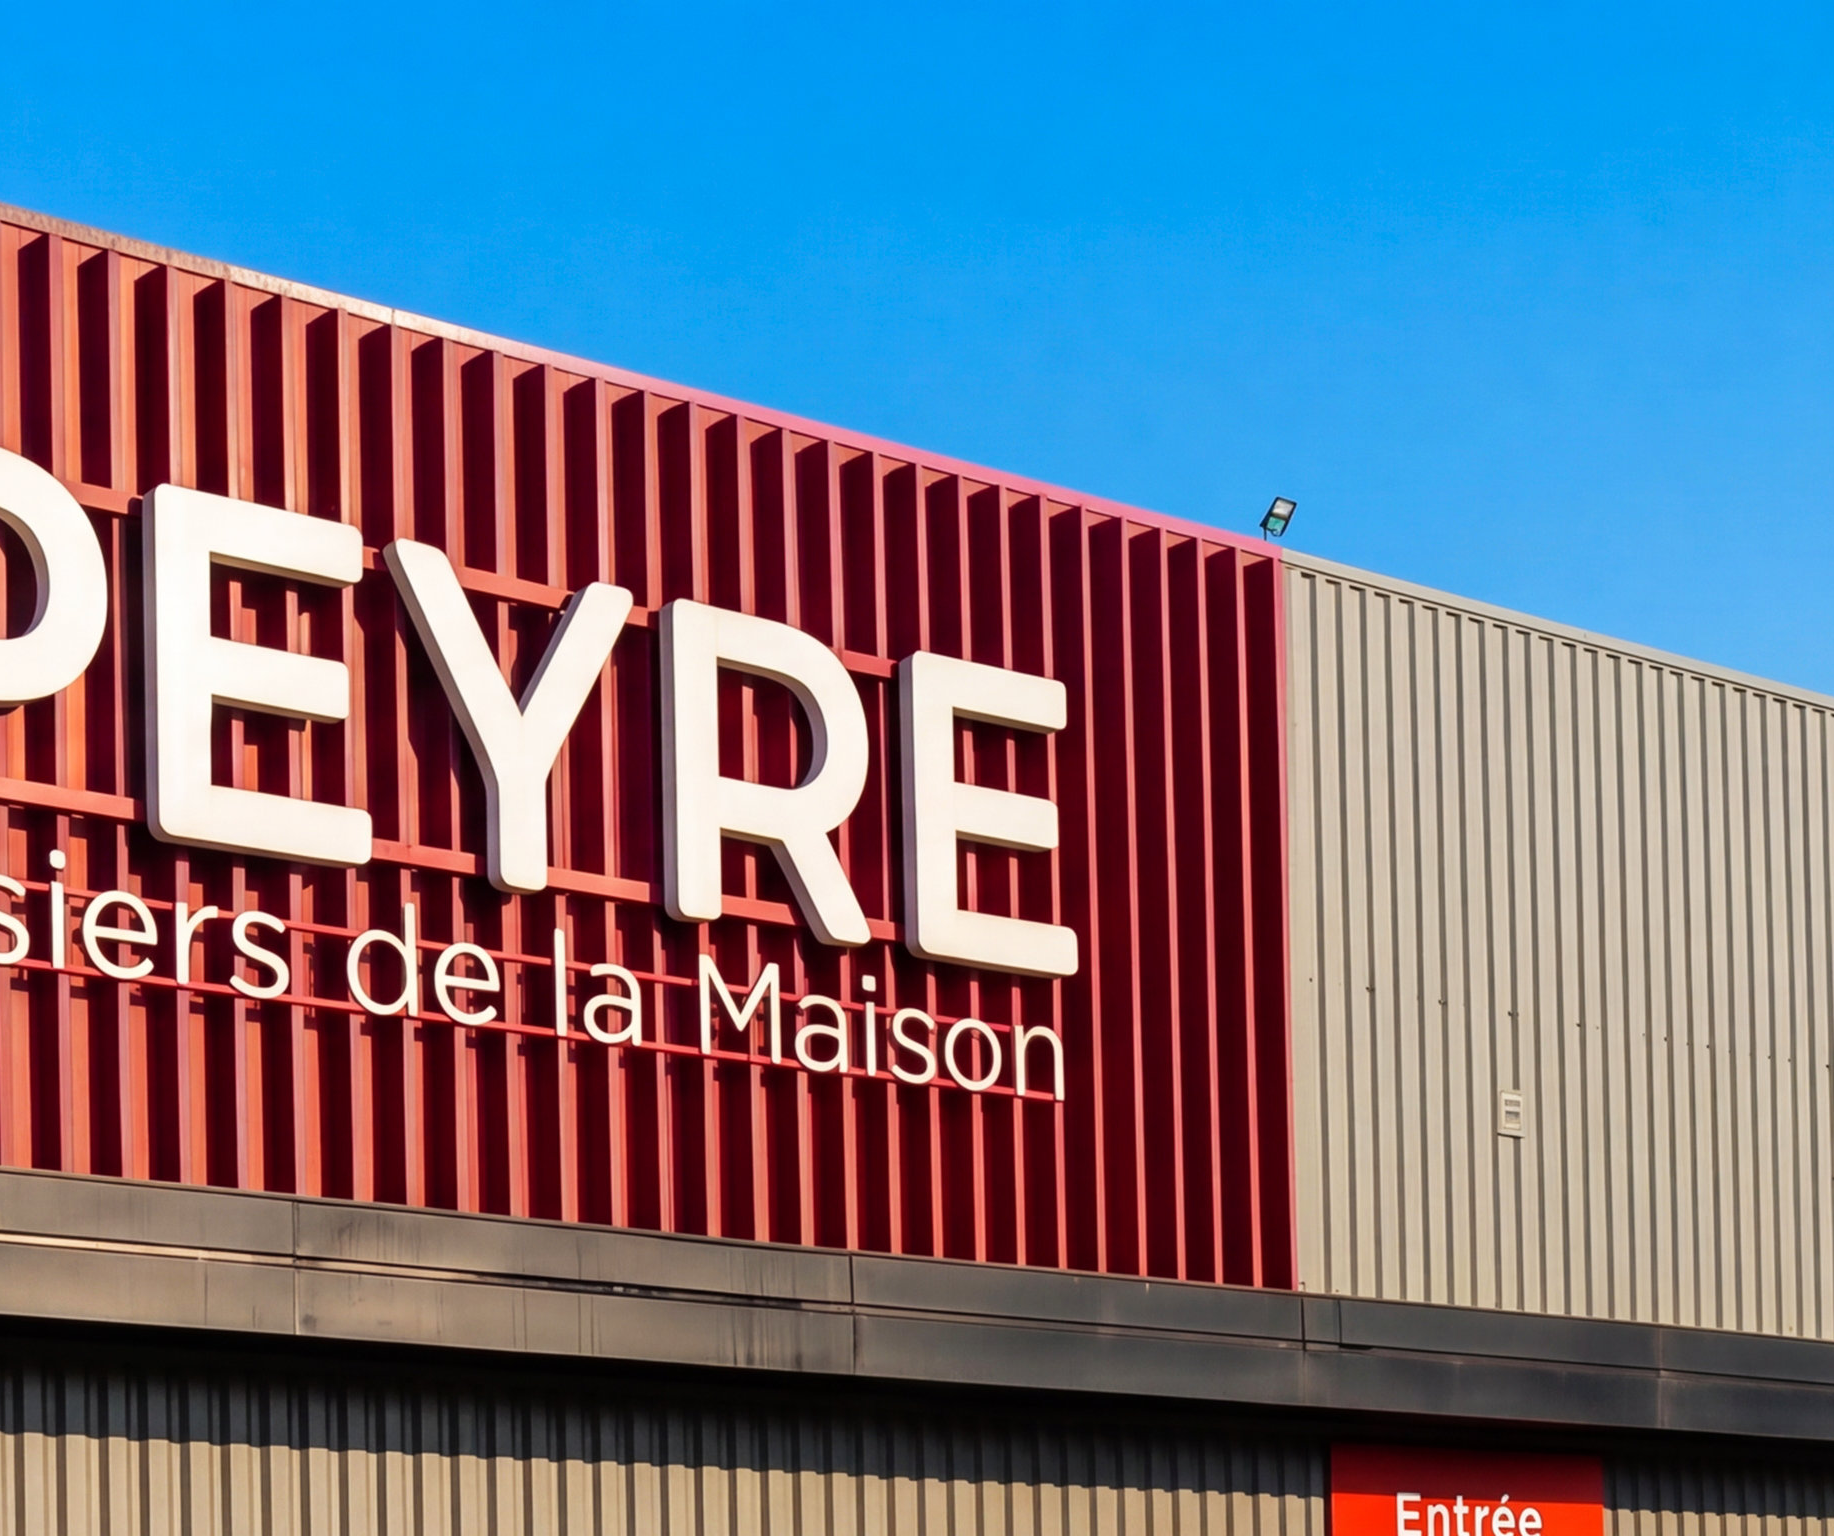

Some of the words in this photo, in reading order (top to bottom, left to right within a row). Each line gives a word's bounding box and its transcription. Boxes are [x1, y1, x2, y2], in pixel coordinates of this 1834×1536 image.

[346, 902, 501, 1027] de
[553, 927, 644, 1048] la
[698, 953, 1066, 1102] Maison
